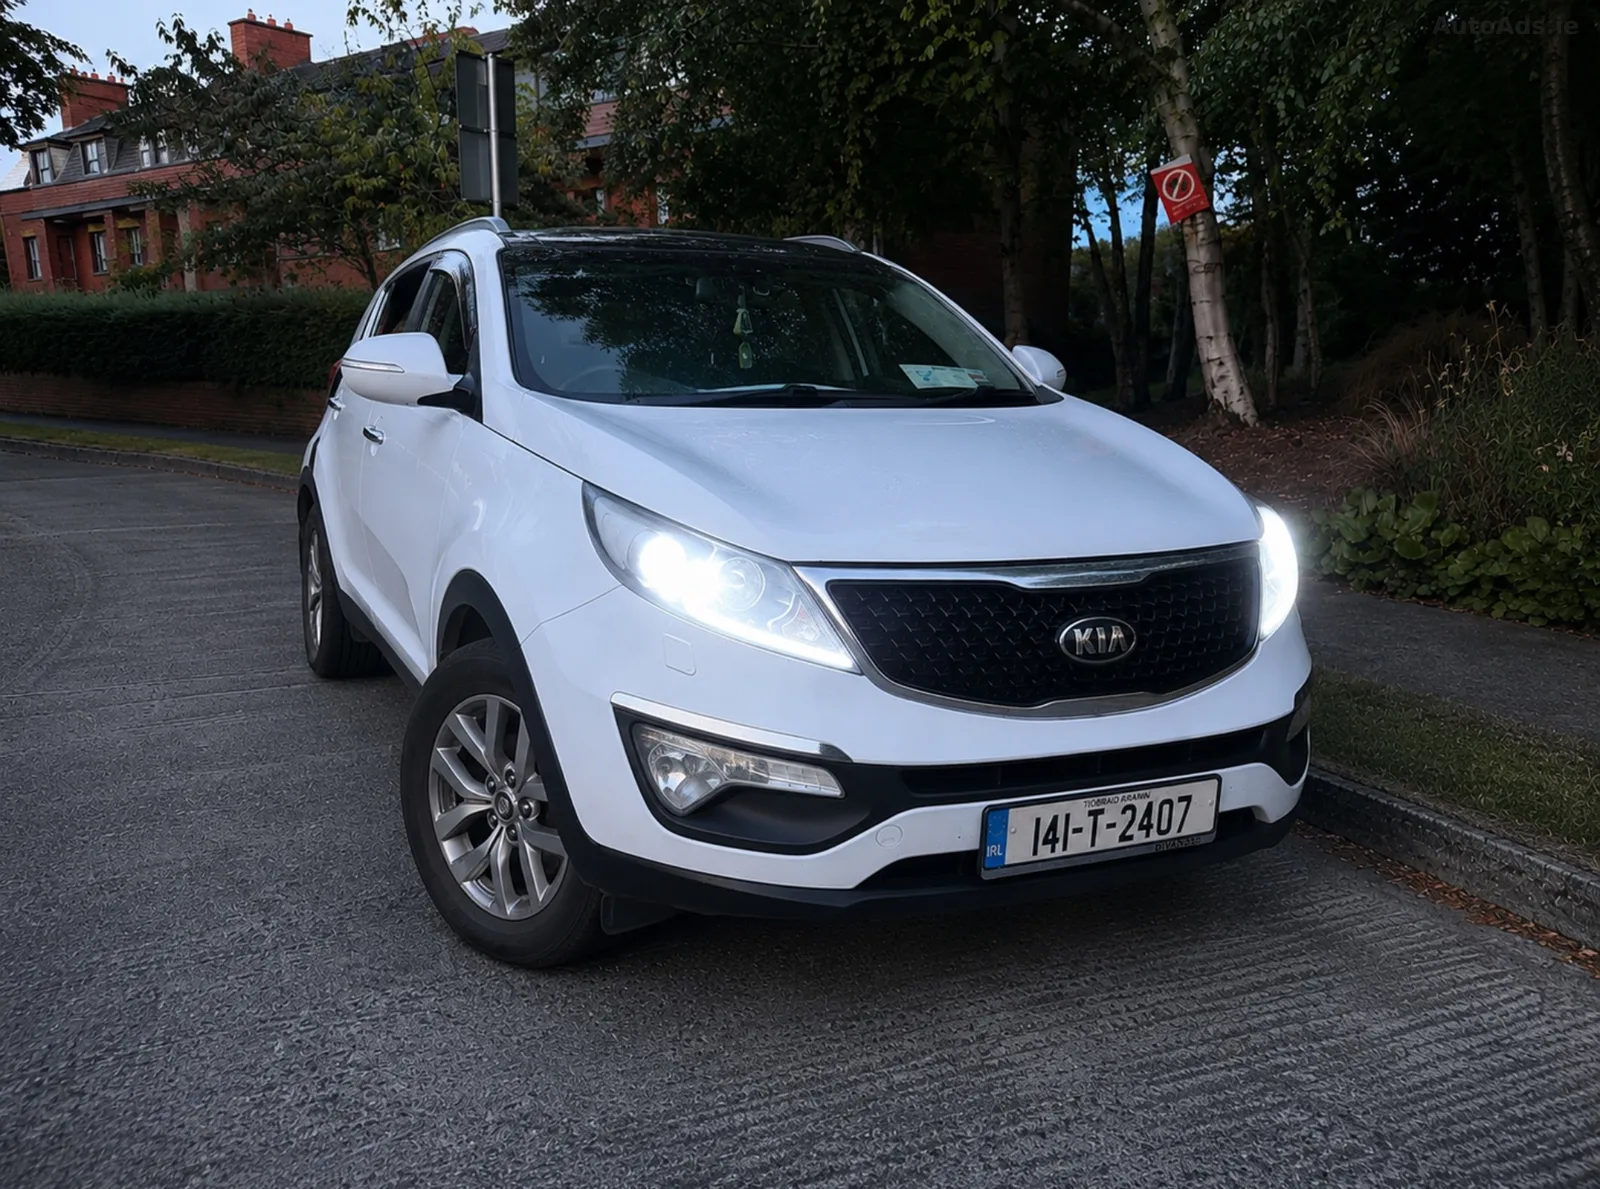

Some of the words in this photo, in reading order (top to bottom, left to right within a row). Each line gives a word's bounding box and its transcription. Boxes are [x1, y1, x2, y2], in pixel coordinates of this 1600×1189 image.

[1072, 625, 1129, 655] KIA
[1032, 795, 1193, 856] 141-T-2407
[986, 844, 1003, 858] IRL
